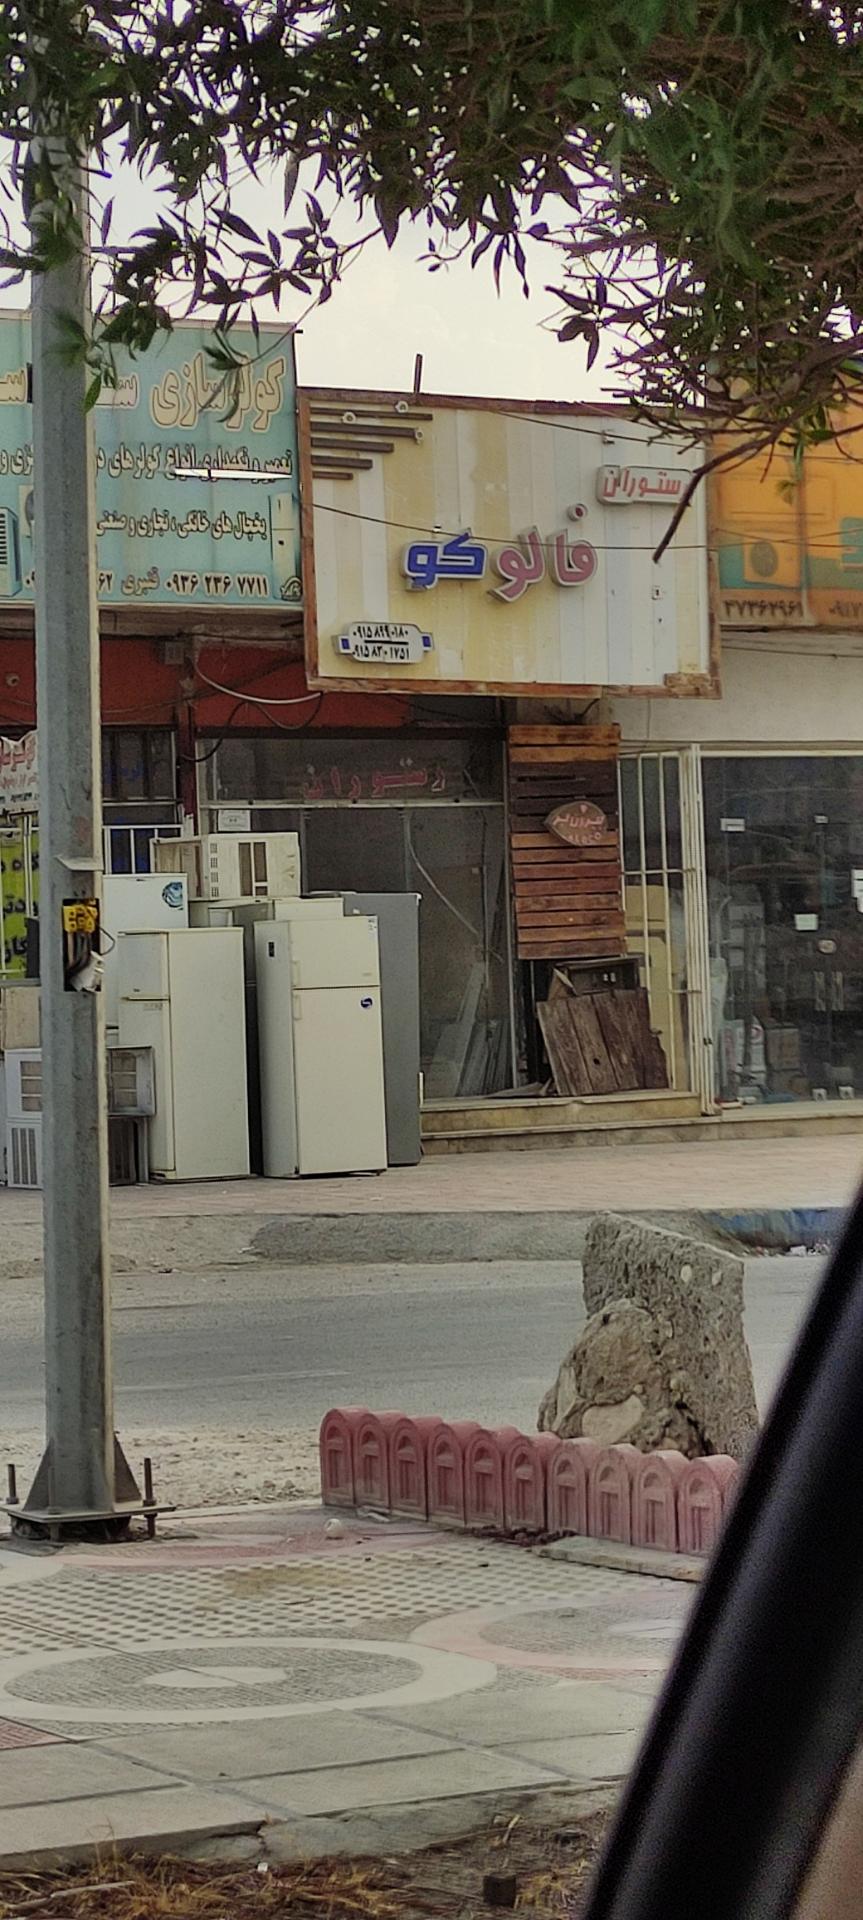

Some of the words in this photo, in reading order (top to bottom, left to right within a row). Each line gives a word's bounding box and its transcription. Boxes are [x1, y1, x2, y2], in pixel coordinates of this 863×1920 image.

[136, 507, 170, 537] تجاری
[233, 511, 268, 542] یخچال
[166, 572, 198, 593] ۰۹۳۶
[205, 573, 231, 594] ۲۳۶
[237, 575, 268, 595] ۷۷۱۱
